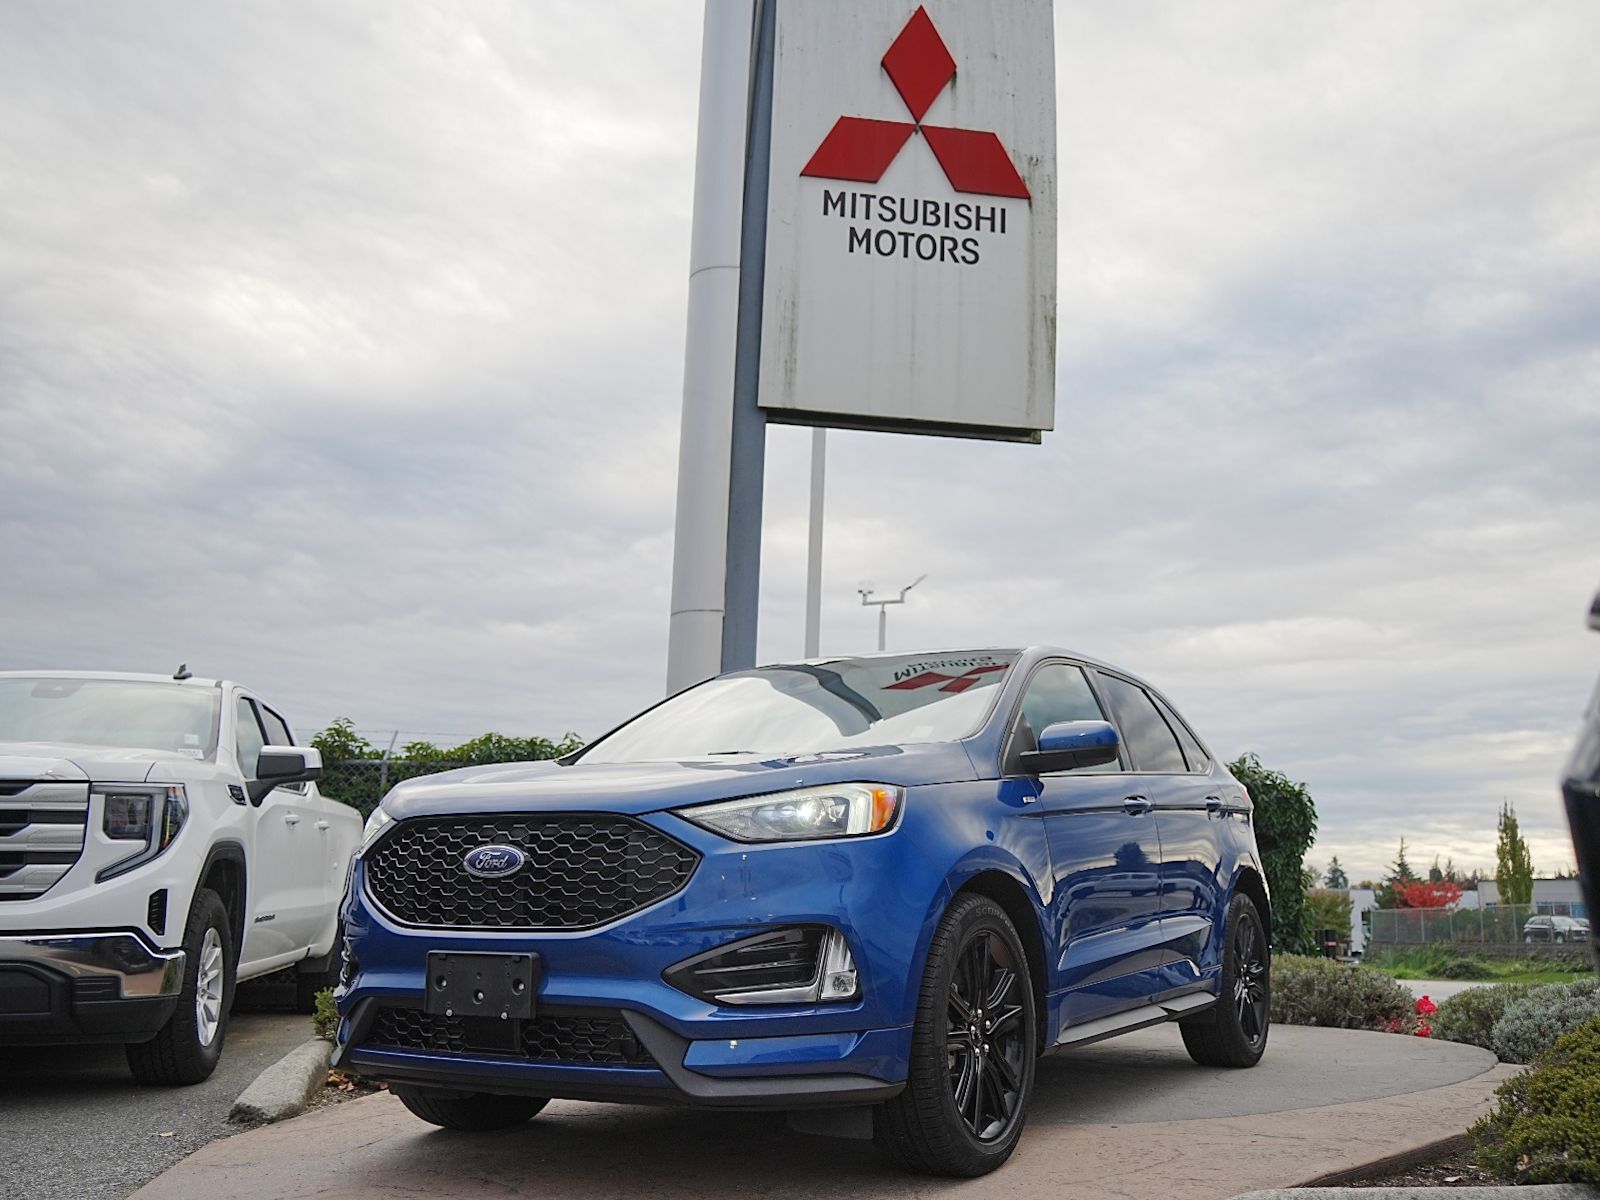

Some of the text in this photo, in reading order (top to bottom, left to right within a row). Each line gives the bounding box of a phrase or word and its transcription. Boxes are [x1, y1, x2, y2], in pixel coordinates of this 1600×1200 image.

[823, 189, 1006, 234] MITSUBISHI
[849, 226, 980, 265] MOTORS
[475, 850, 510, 869] Ford
